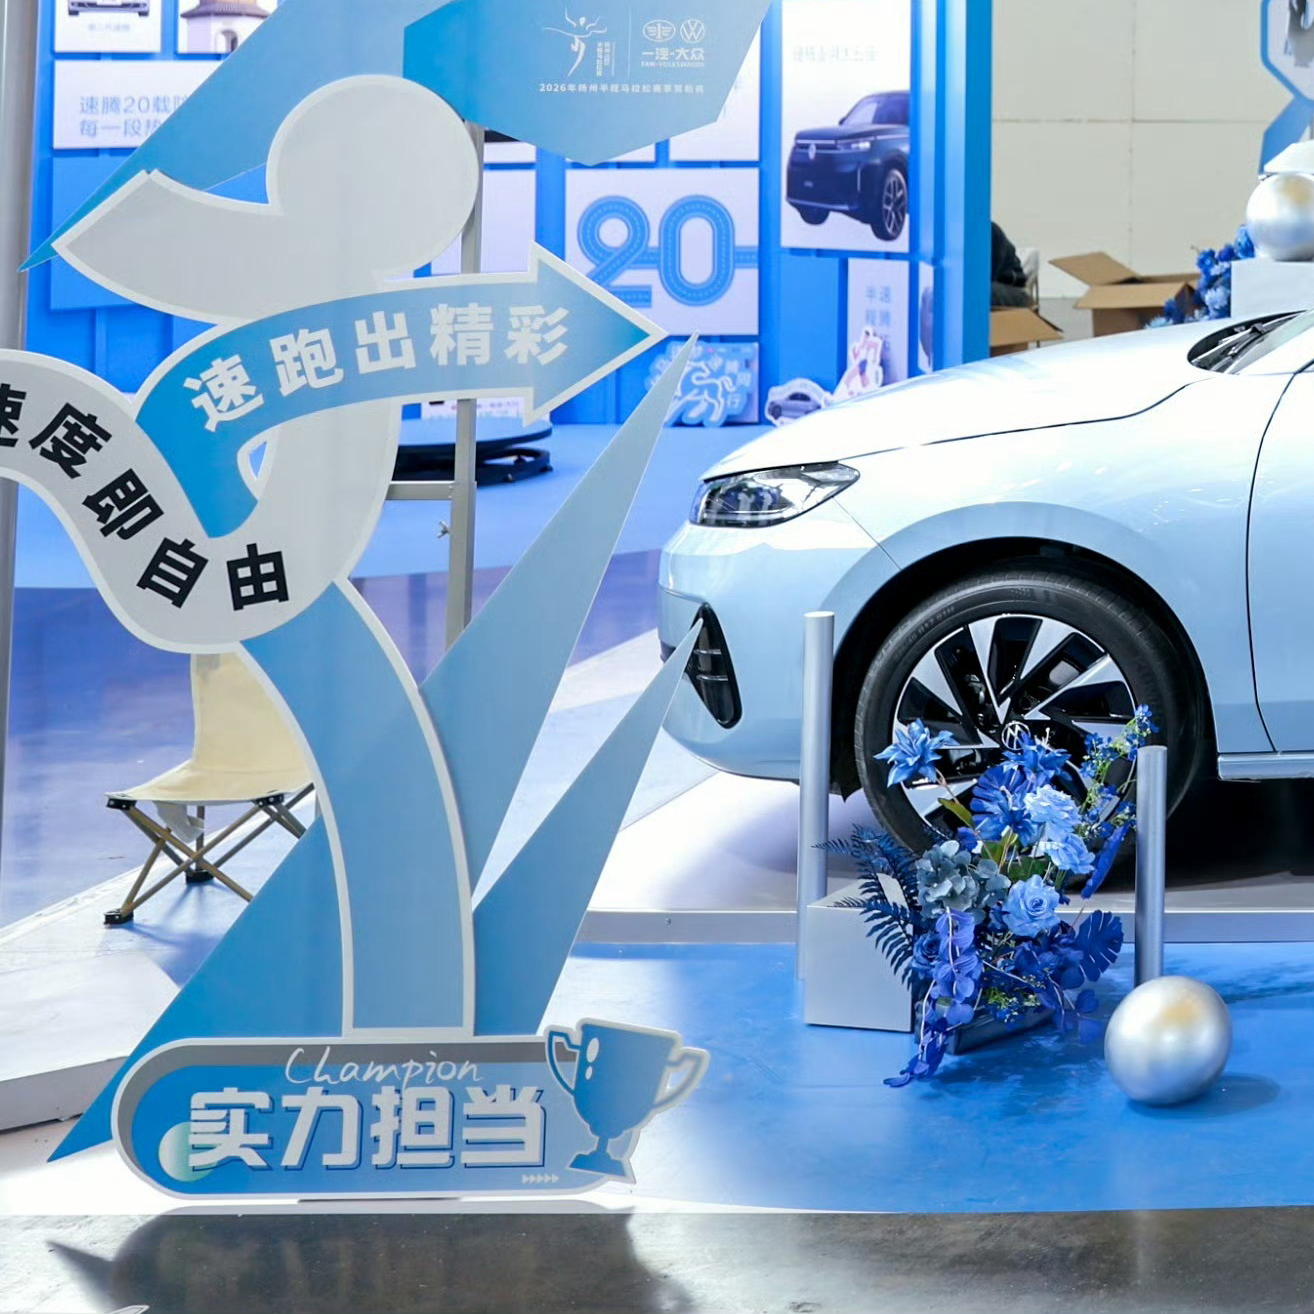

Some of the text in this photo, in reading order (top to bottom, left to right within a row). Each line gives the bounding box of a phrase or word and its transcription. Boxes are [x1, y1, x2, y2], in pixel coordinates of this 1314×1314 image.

[182, 302, 570, 432] 速跑出精彩
[285, 1046, 484, 1088] Champion
[188, 1084, 548, 1170] 实力担当
